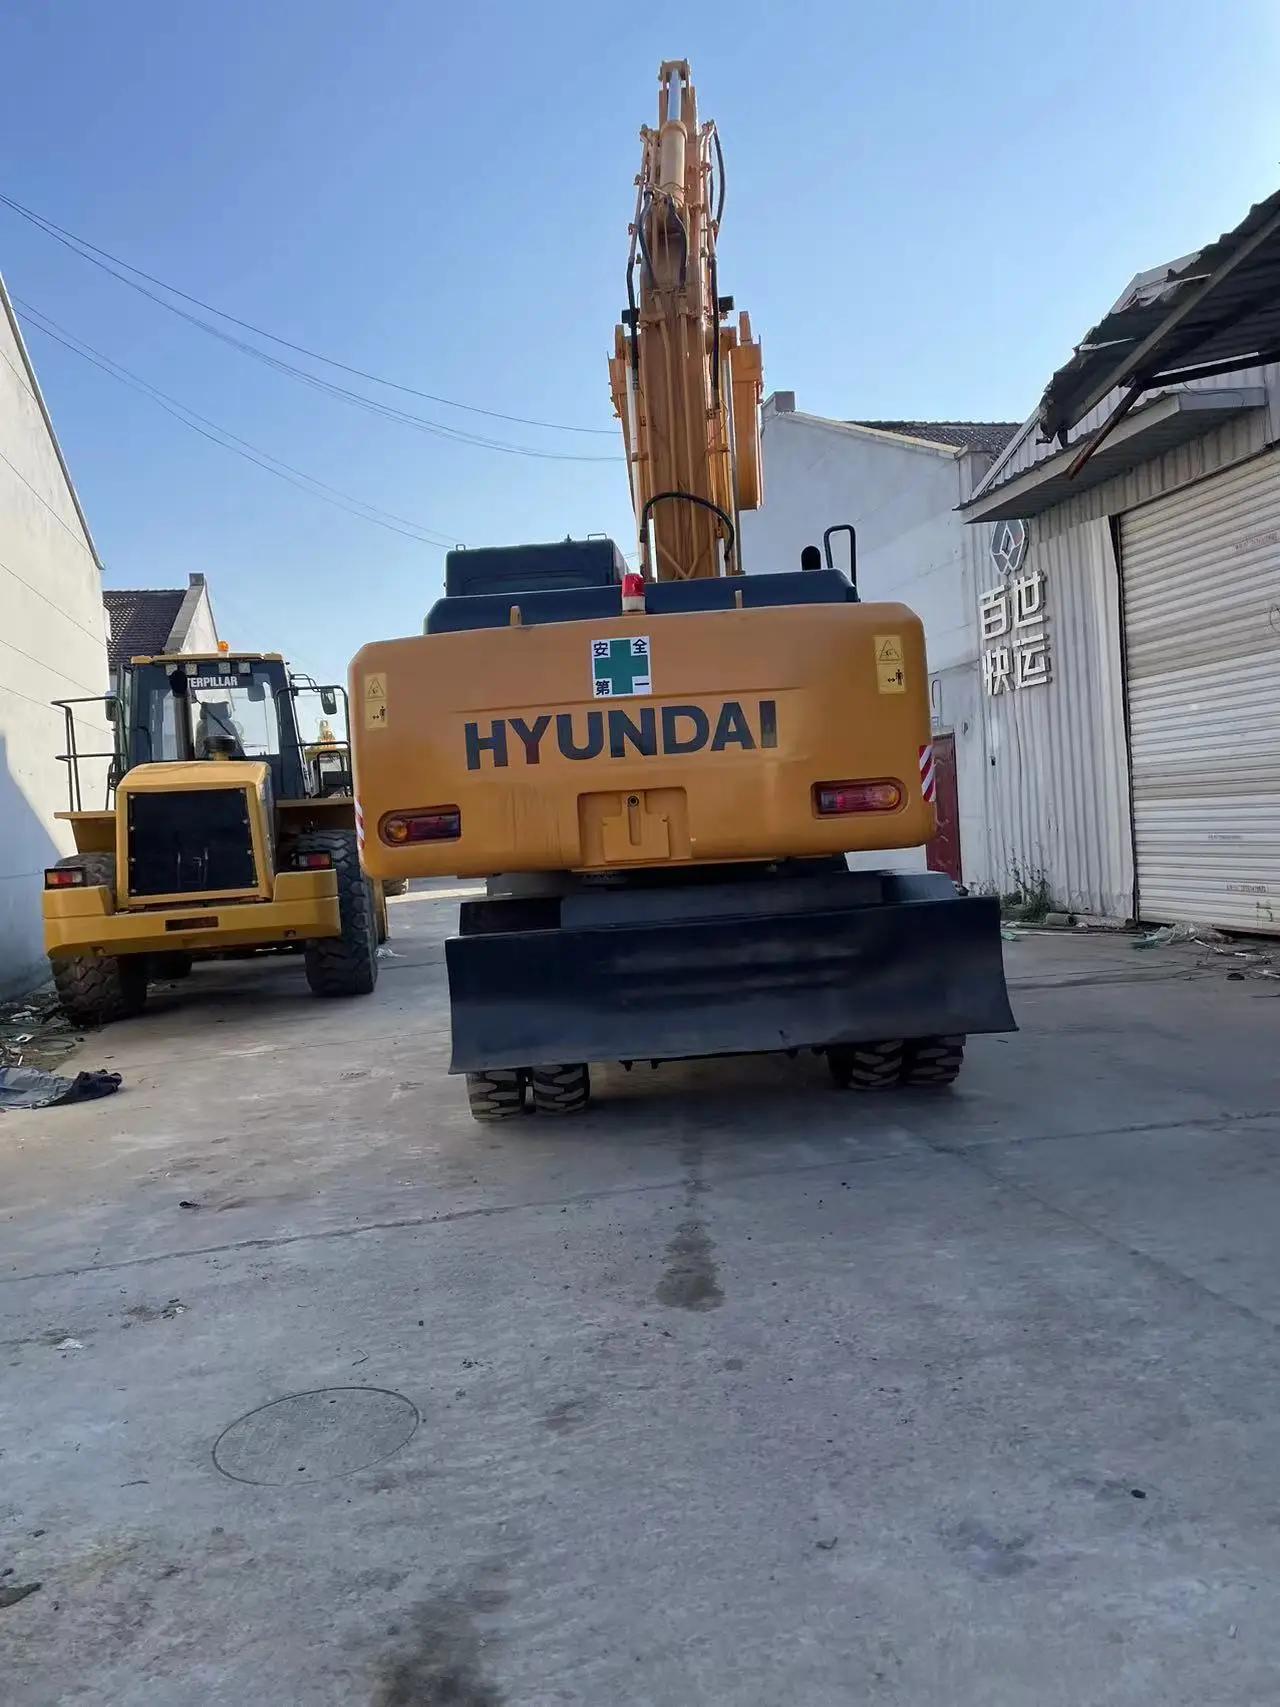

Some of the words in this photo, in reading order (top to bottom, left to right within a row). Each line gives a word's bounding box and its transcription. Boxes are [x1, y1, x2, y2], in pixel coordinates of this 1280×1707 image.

[979, 571, 1043, 640] 百世
[594, 639, 648, 657] 安全
[982, 633, 1047, 696] 快运
[187, 676, 238, 689] TERPILLAR
[596, 680, 650, 696] 第一
[464, 700, 777, 770] HYUNDAI
